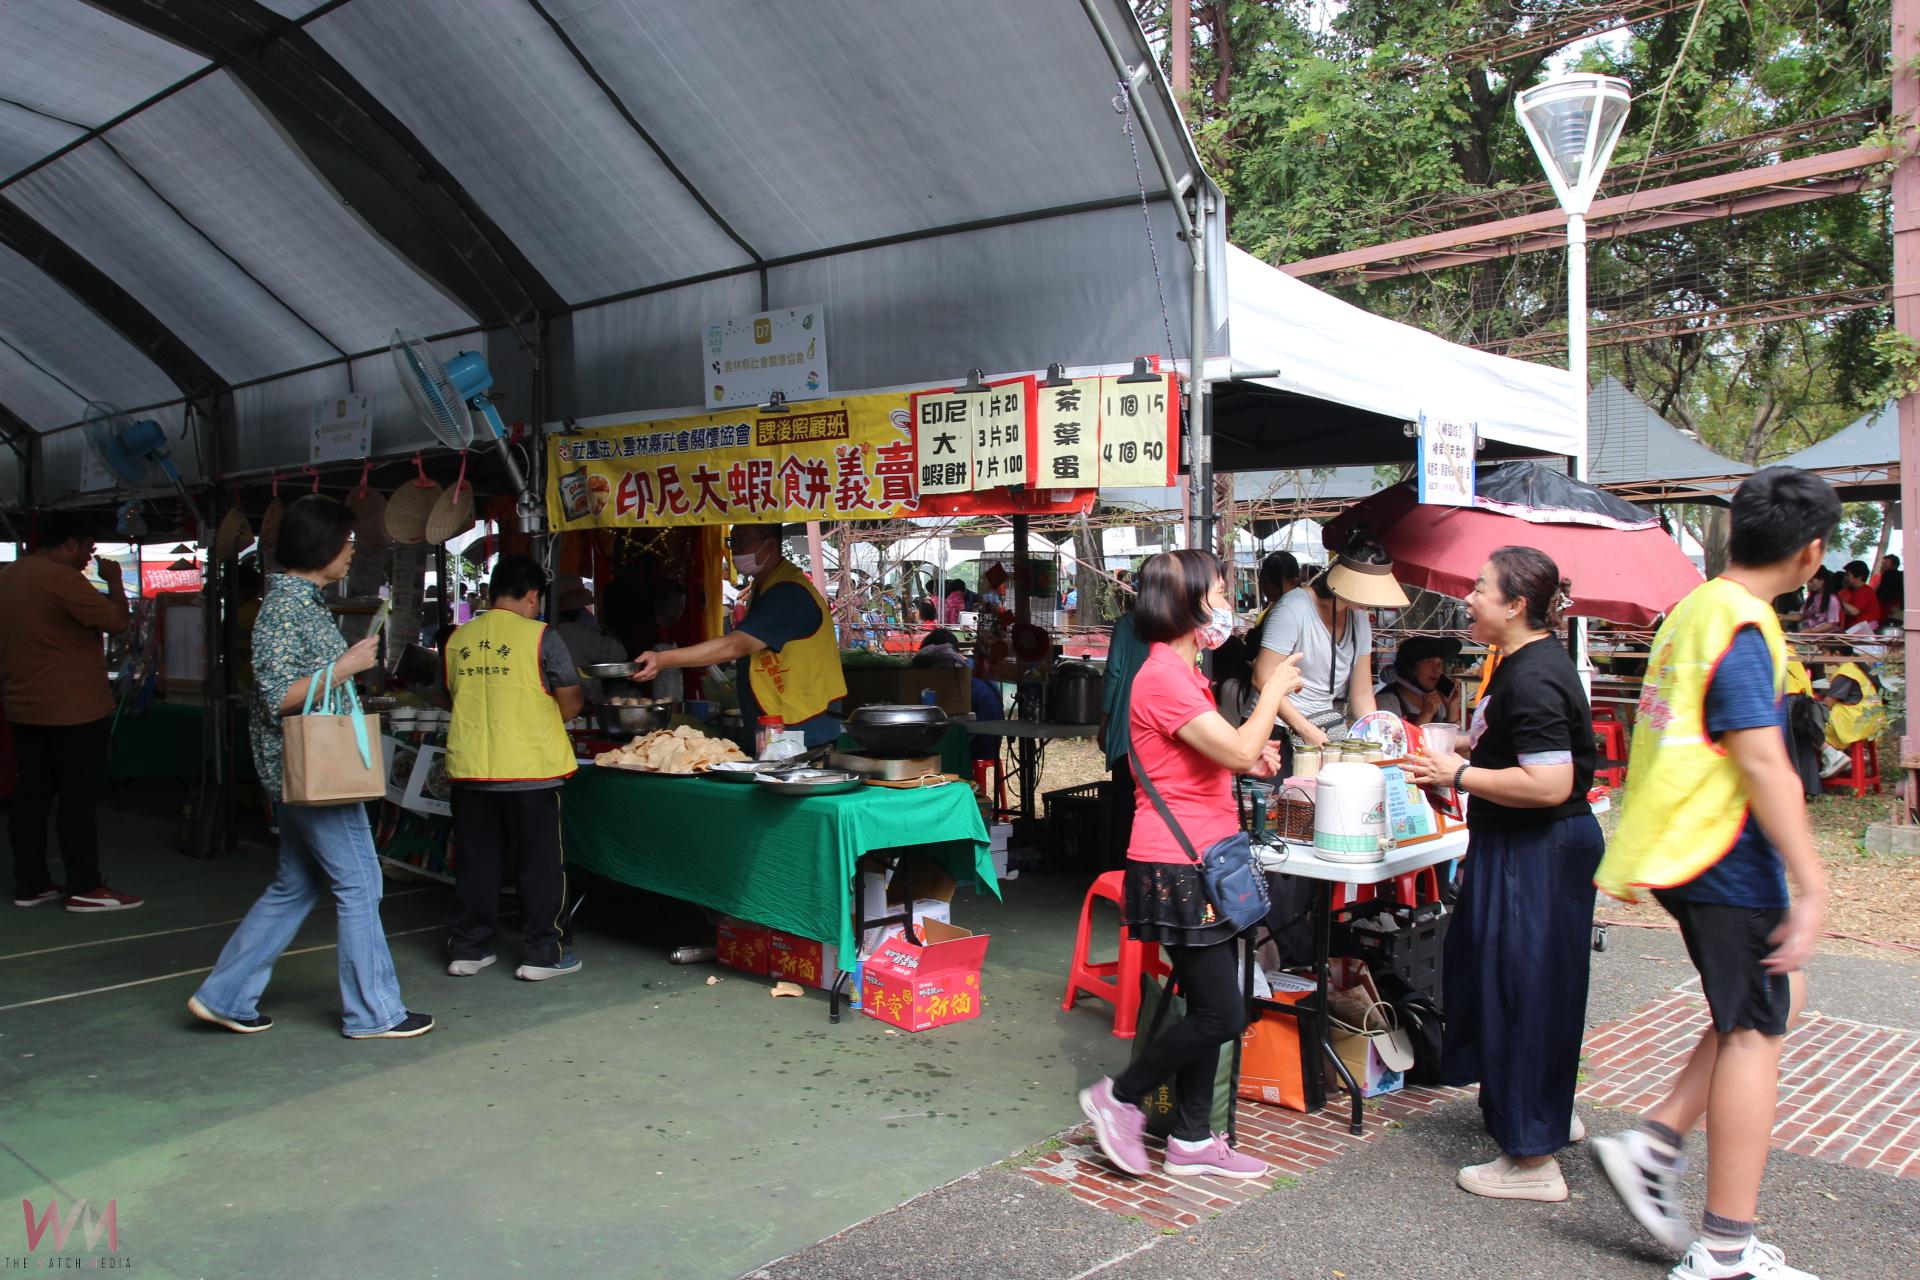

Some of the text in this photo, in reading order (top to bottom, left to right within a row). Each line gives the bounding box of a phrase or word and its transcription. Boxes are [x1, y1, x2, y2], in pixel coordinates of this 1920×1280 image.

[756, 325, 769, 338] D7
[921, 399, 967, 425] 印尼
[758, 413, 846, 444] 課後照顧班
[1052, 388, 1082, 479] 茶葉蛋
[932, 432, 956, 455] 大
[614, 440, 920, 521] 印尼大蝦餅義賣
[921, 462, 967, 487] 蝦餅
[871, 989, 903, 1021] 平安
